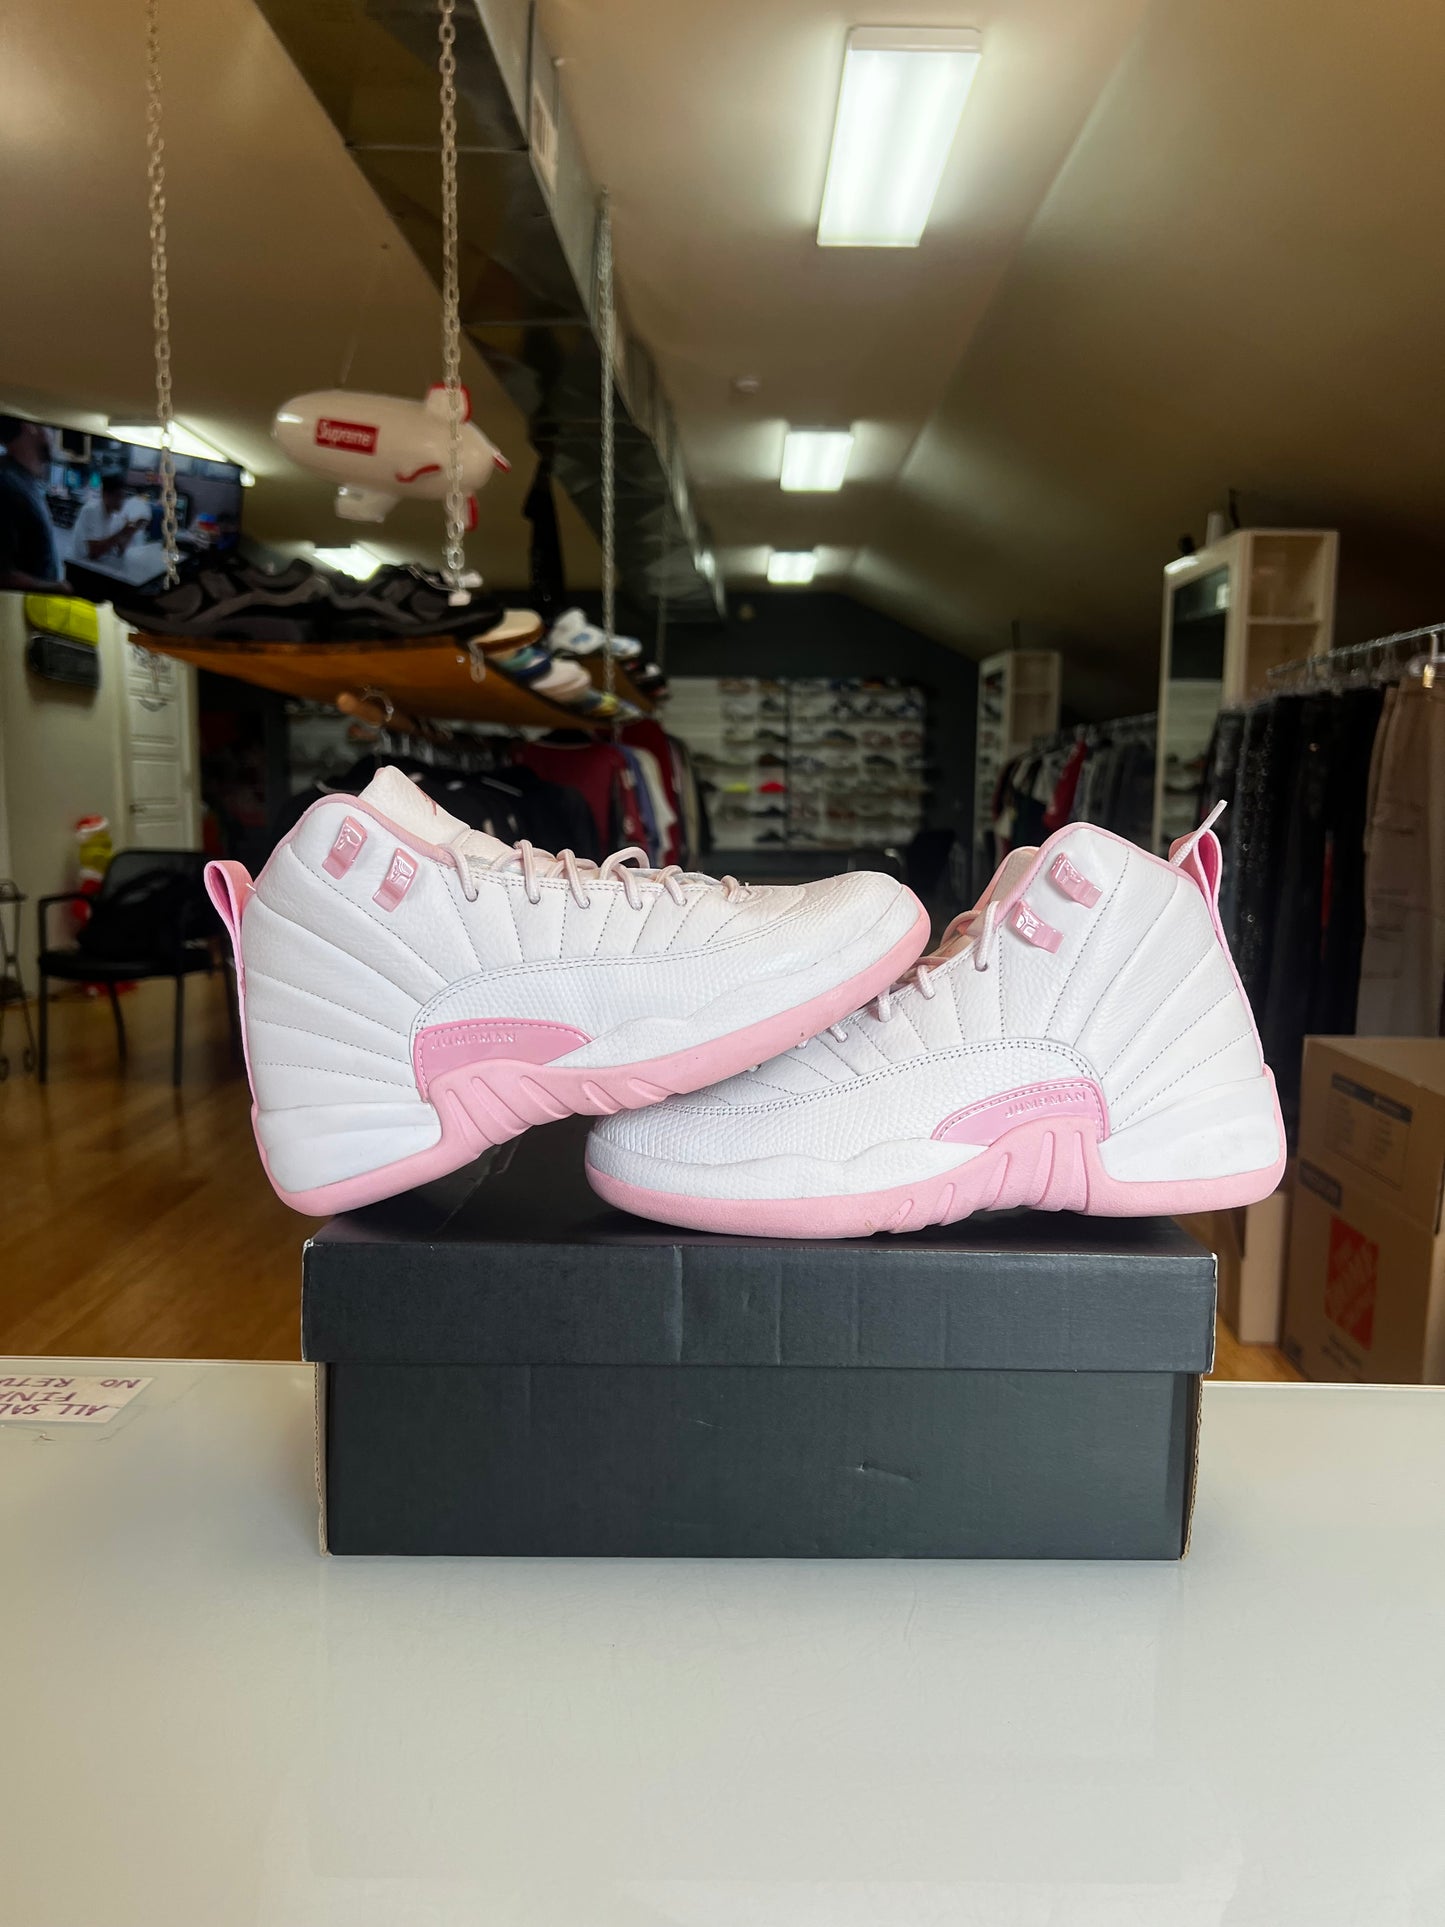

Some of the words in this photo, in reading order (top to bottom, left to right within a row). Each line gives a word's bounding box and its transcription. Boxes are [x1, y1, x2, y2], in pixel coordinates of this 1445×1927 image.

[320, 421, 371, 447] Supreme
[431, 1032, 515, 1050] JUMPMAN
[1004, 1091, 1086, 1118] JUMPMAN
[100, 1379, 141, 1389] NO
[59, 1403, 108, 1416] ALL
